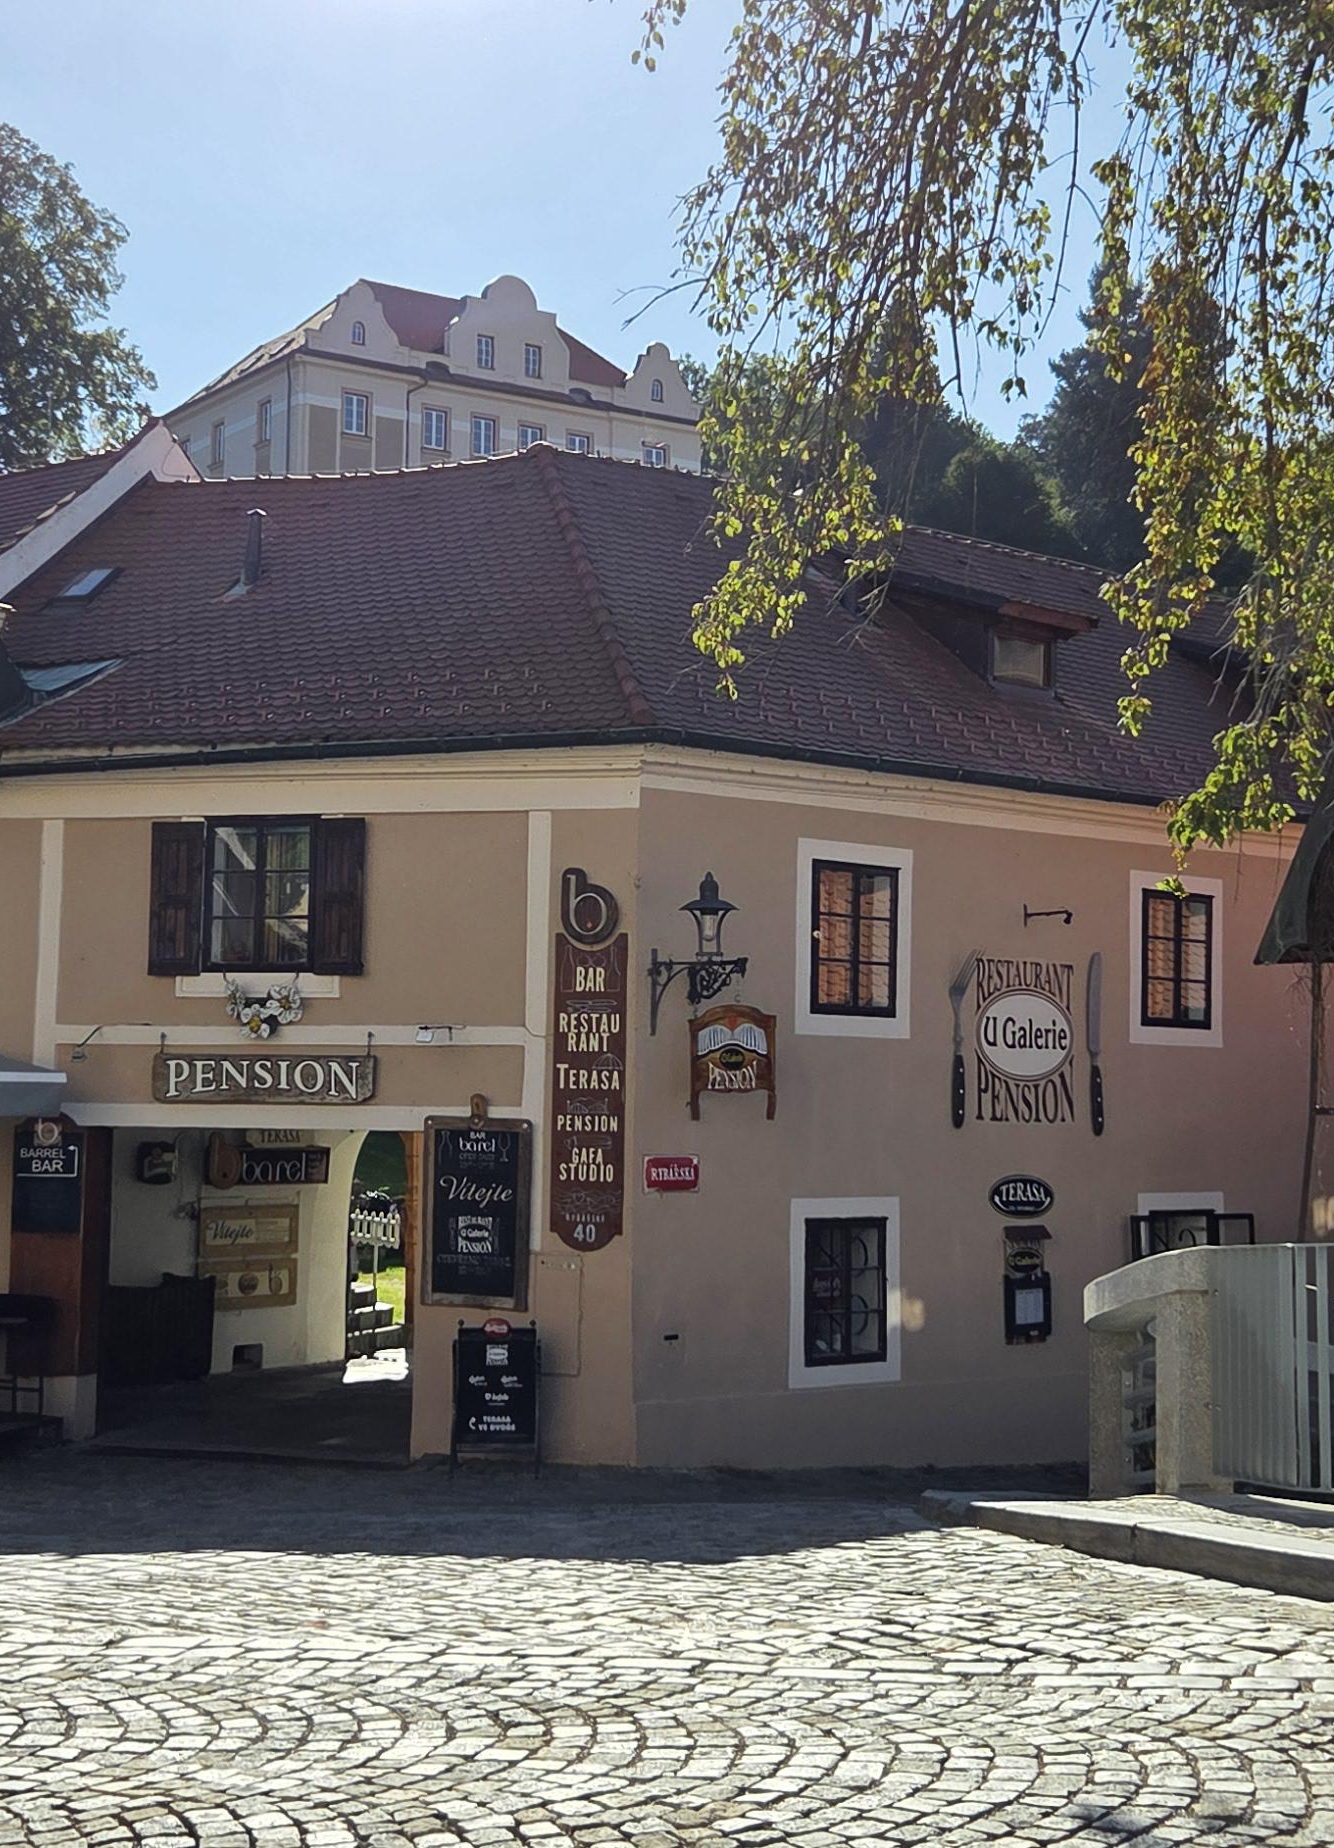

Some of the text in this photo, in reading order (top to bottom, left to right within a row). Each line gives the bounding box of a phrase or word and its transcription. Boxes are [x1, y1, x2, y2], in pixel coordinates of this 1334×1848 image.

[575, 967, 605, 992] BAR
[976, 958, 1074, 1016] RESTAURANT
[559, 1013, 620, 1034] RESTAU
[984, 1016, 1068, 1050] U Galerie
[567, 1032, 610, 1052] RANT
[165, 1059, 360, 1100] PENSION
[556, 1064, 620, 1090] TERASA
[708, 1060, 757, 1090] PENSION
[975, 1048, 1075, 1123] PENSION
[557, 1115, 618, 1132] PENSION
[459, 1137, 496, 1152] barel
[470, 1131, 486, 1139] BAR
[20, 1147, 67, 1159] BARREL
[572, 1148, 603, 1164] GAFA
[31, 1159, 64, 1172] BAR
[243, 1152, 306, 1182] barel
[559, 1164, 614, 1182] STUDIO
[1000, 1182, 1046, 1201] TERASA
[573, 1223, 596, 1242] 40
